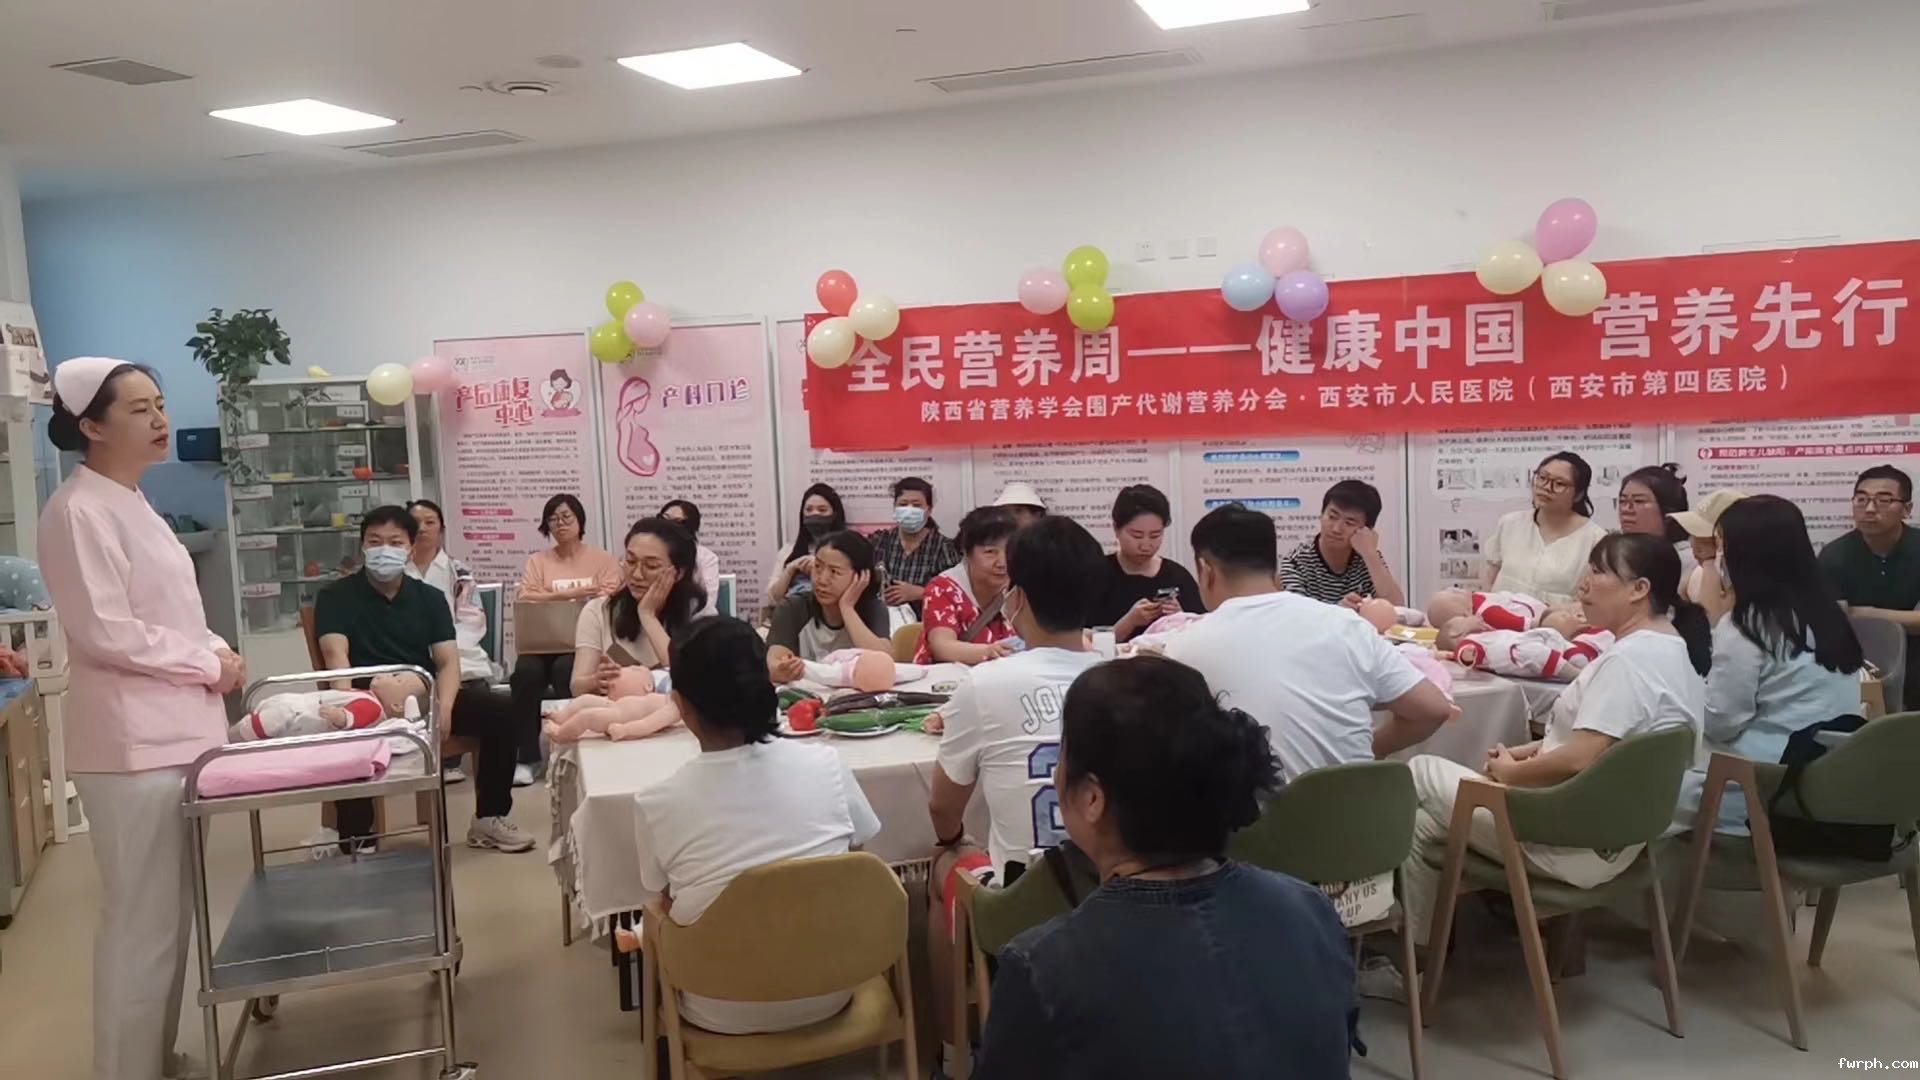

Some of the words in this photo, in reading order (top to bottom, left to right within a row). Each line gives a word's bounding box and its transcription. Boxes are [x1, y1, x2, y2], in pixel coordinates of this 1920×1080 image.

[1593, 277, 1908, 361] 营养先行
[455, 376, 531, 413] 产后康复
[661, 377, 750, 408] 产科门诊
[494, 401, 534, 429] 中心
[1020, 682, 1064, 735] JO
